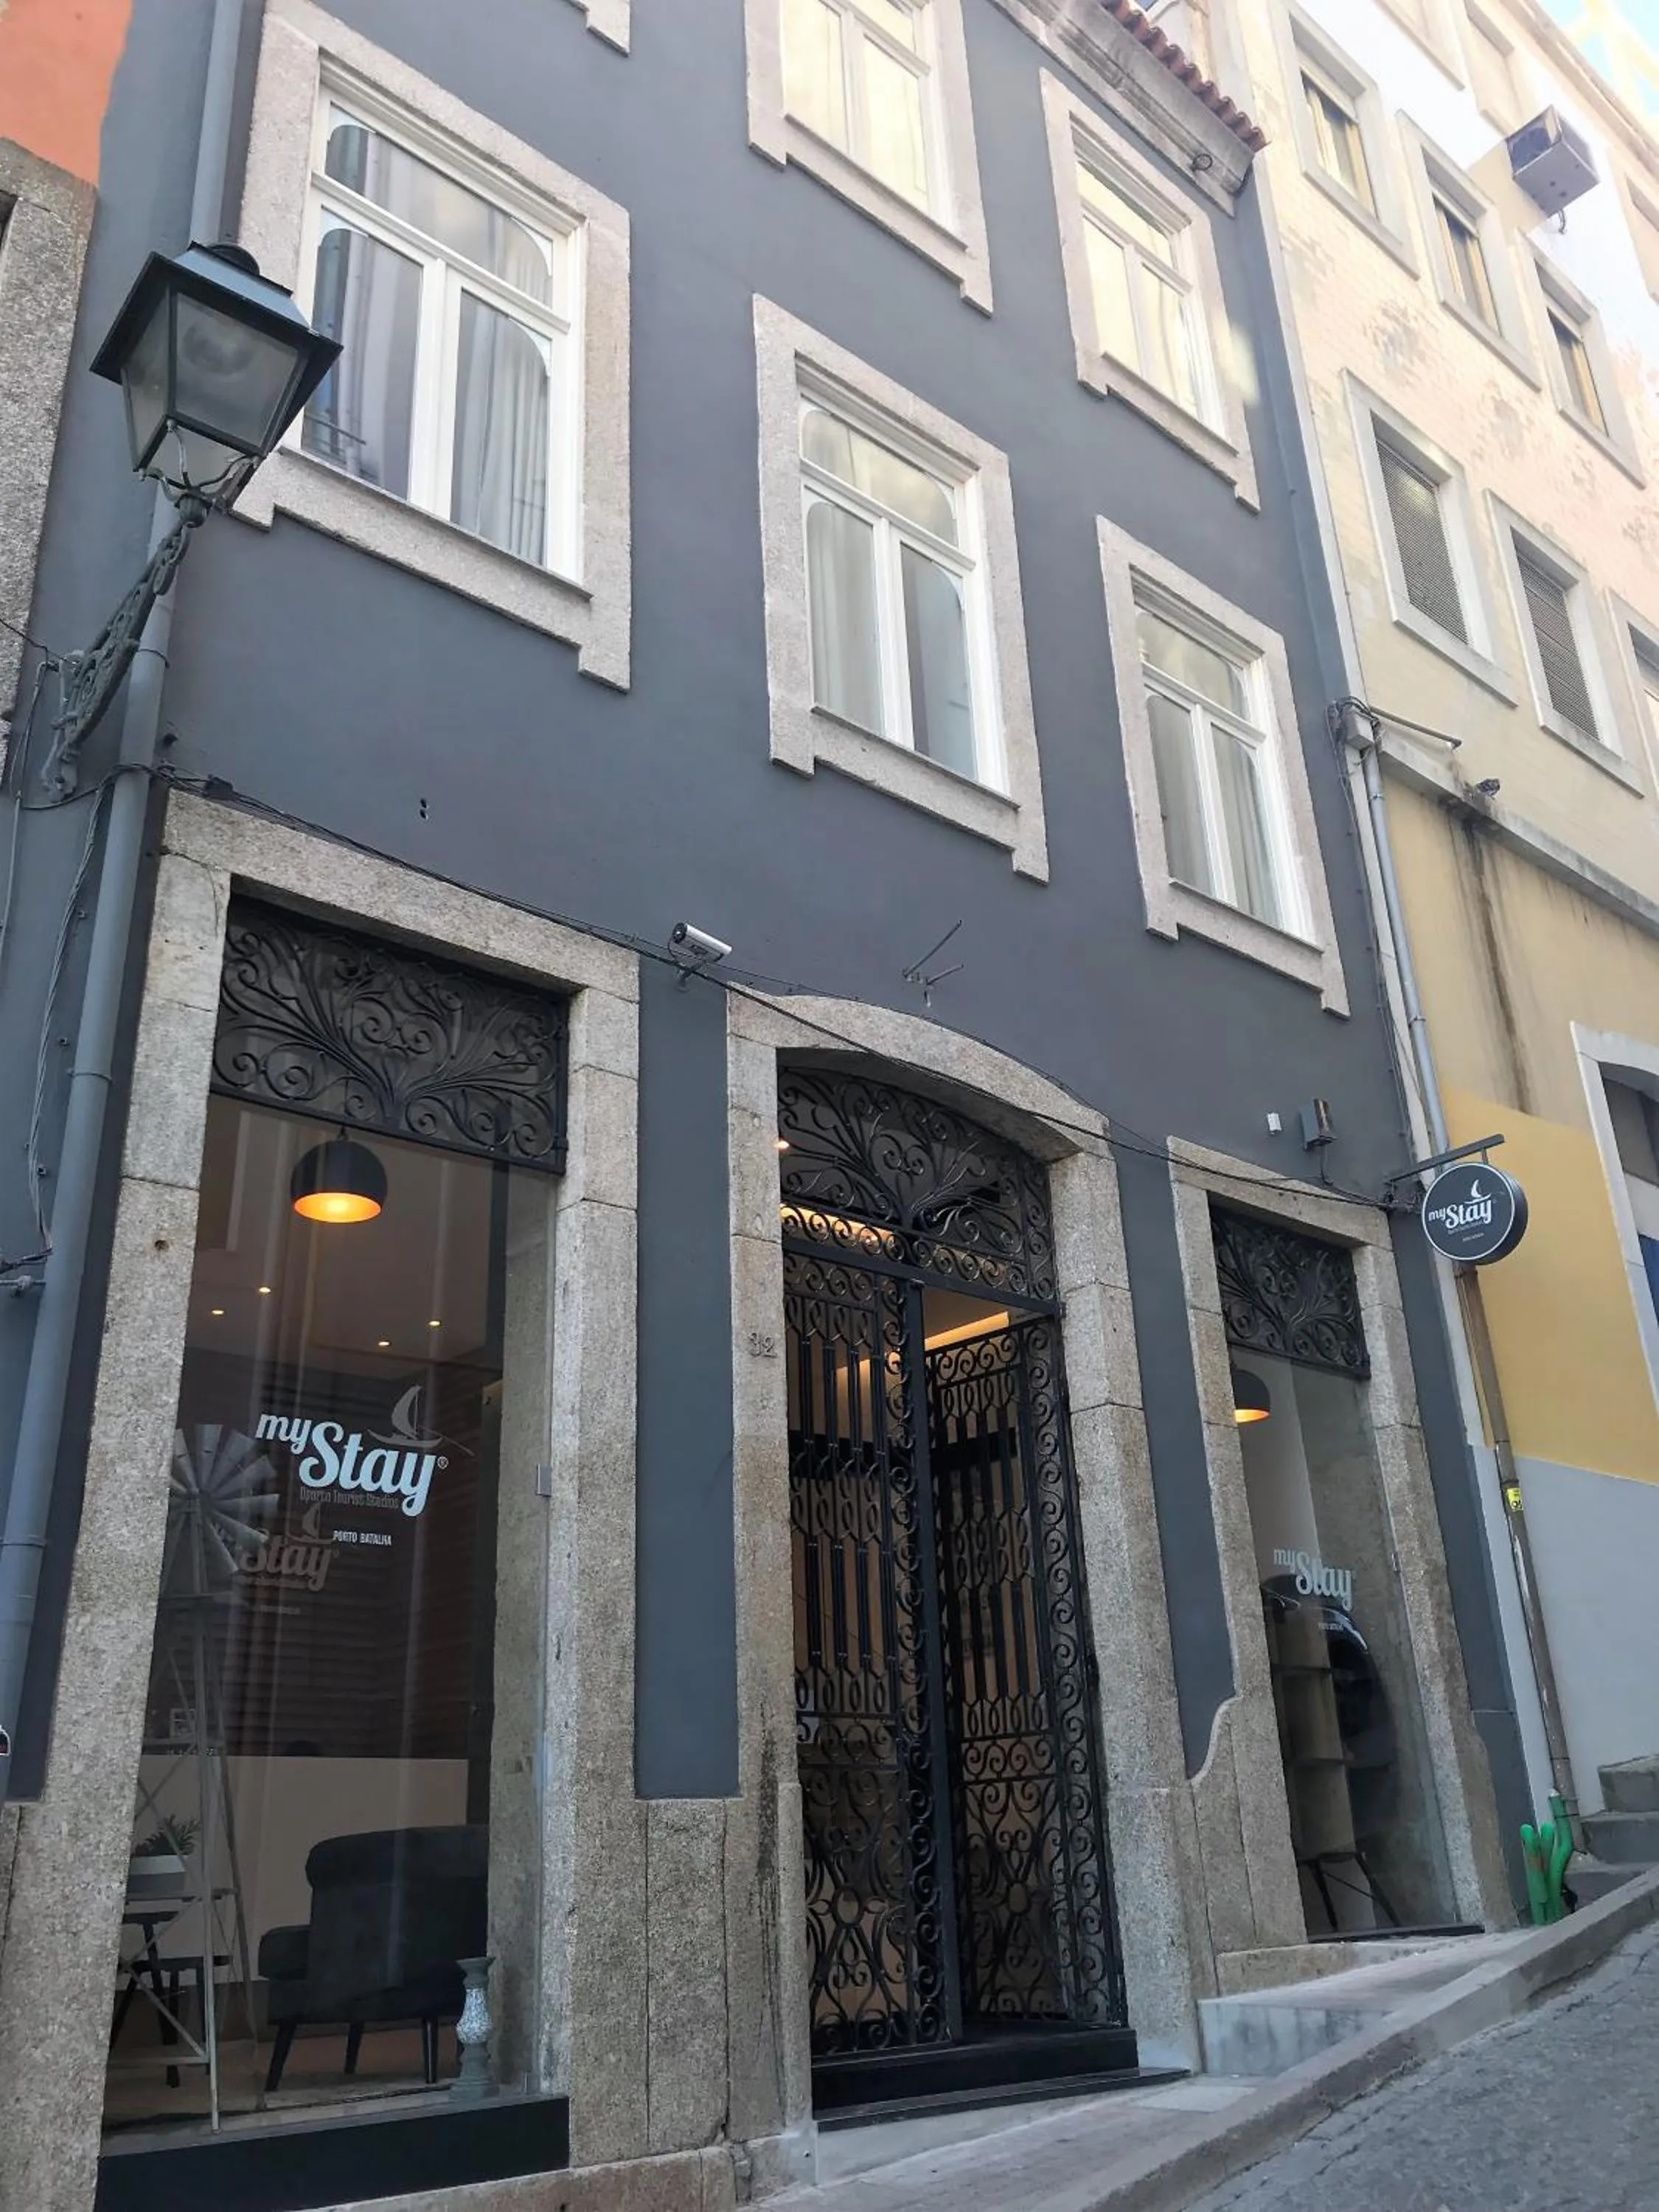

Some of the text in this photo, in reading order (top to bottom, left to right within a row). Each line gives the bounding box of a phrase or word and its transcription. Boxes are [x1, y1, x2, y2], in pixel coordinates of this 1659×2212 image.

[746, 1332, 777, 1358] 32
[333, 1530, 392, 1546] PORTO BATALHA
